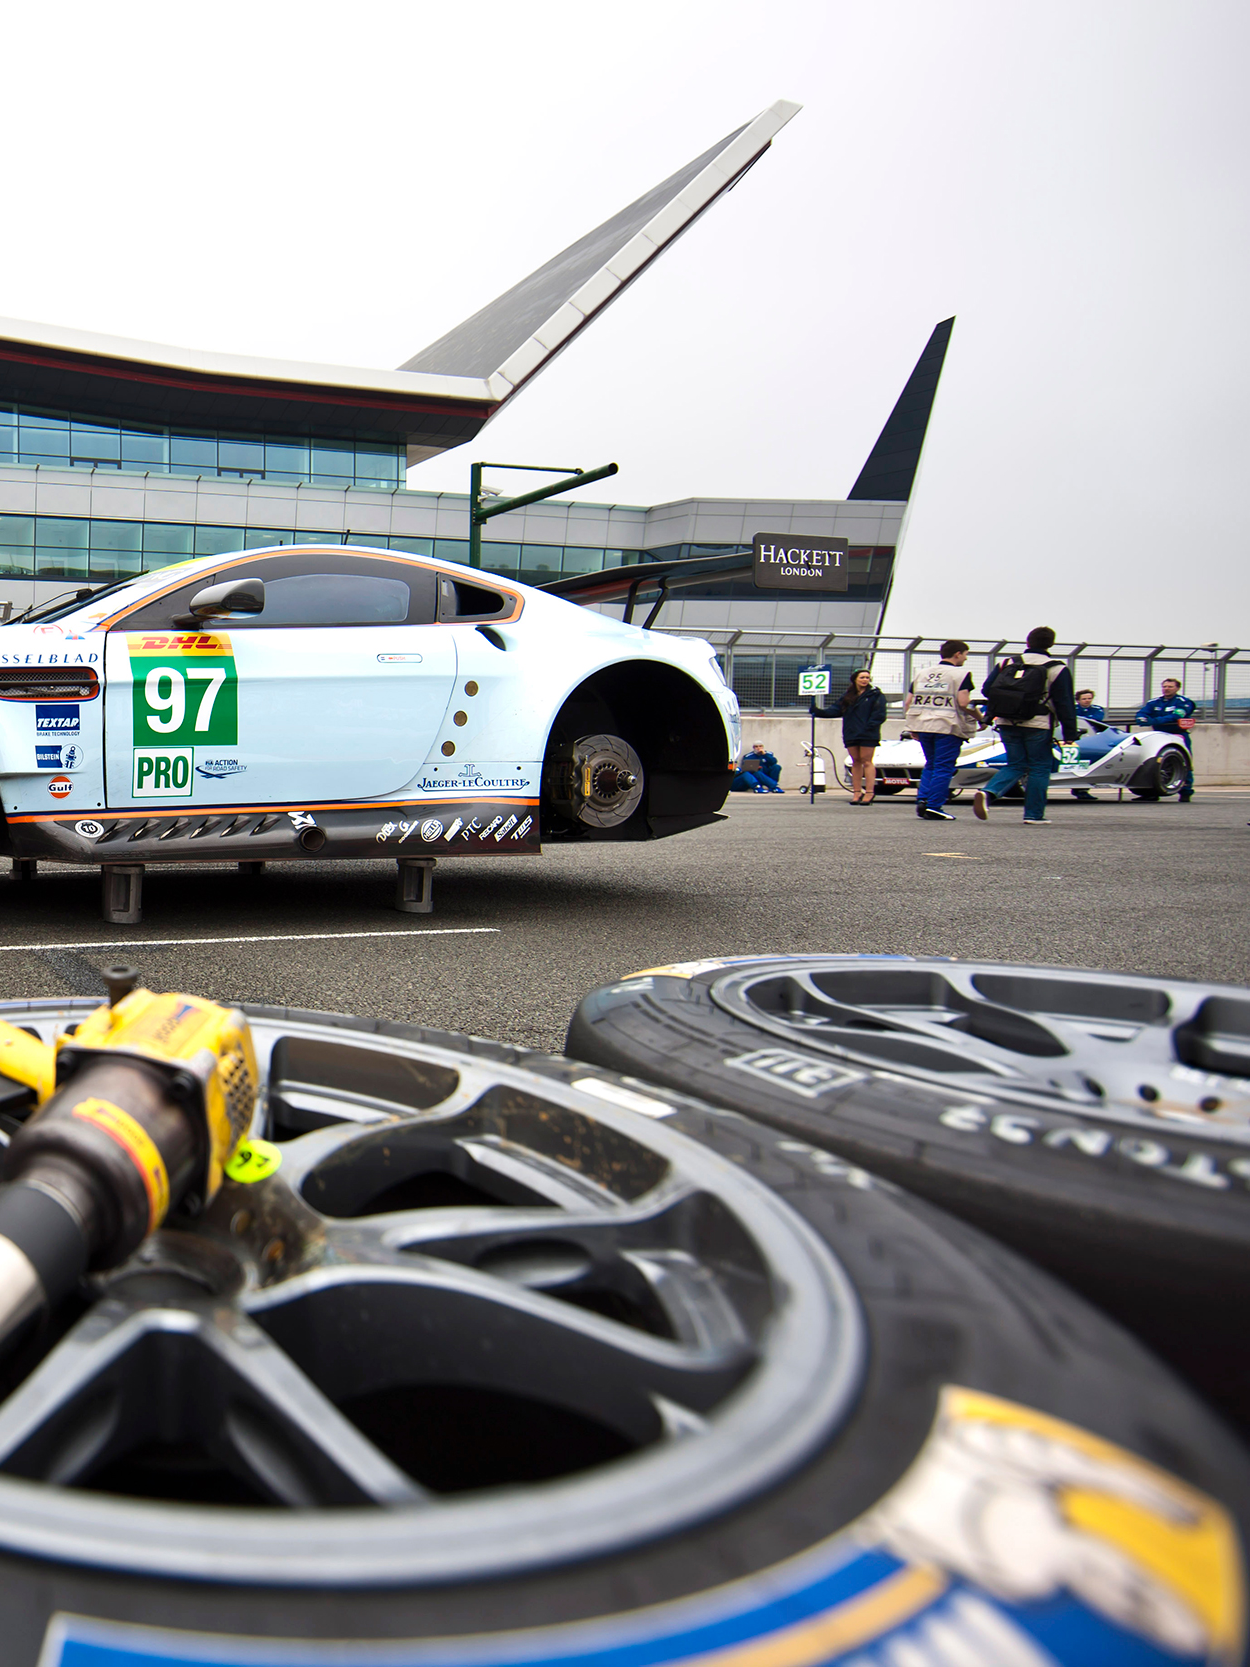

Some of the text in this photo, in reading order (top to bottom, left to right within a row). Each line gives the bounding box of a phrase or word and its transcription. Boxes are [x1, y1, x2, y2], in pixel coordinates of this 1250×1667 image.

[759, 544, 844, 567] HACKETT
[780, 566, 823, 577] LONDON
[141, 636, 218, 650] DHL
[802, 673, 827, 690] 52
[144, 666, 227, 734] 97
[214, 758, 238, 766] ACTION
[1062, 747, 1079, 764] 52
[137, 755, 189, 790] PRO
[48, 784, 73, 792] Gulf
[82, 824, 96, 833] 10
[423, 819, 442, 839] HELLA
[478, 815, 503, 841] RECARO
[236, 1151, 271, 1168] 97
